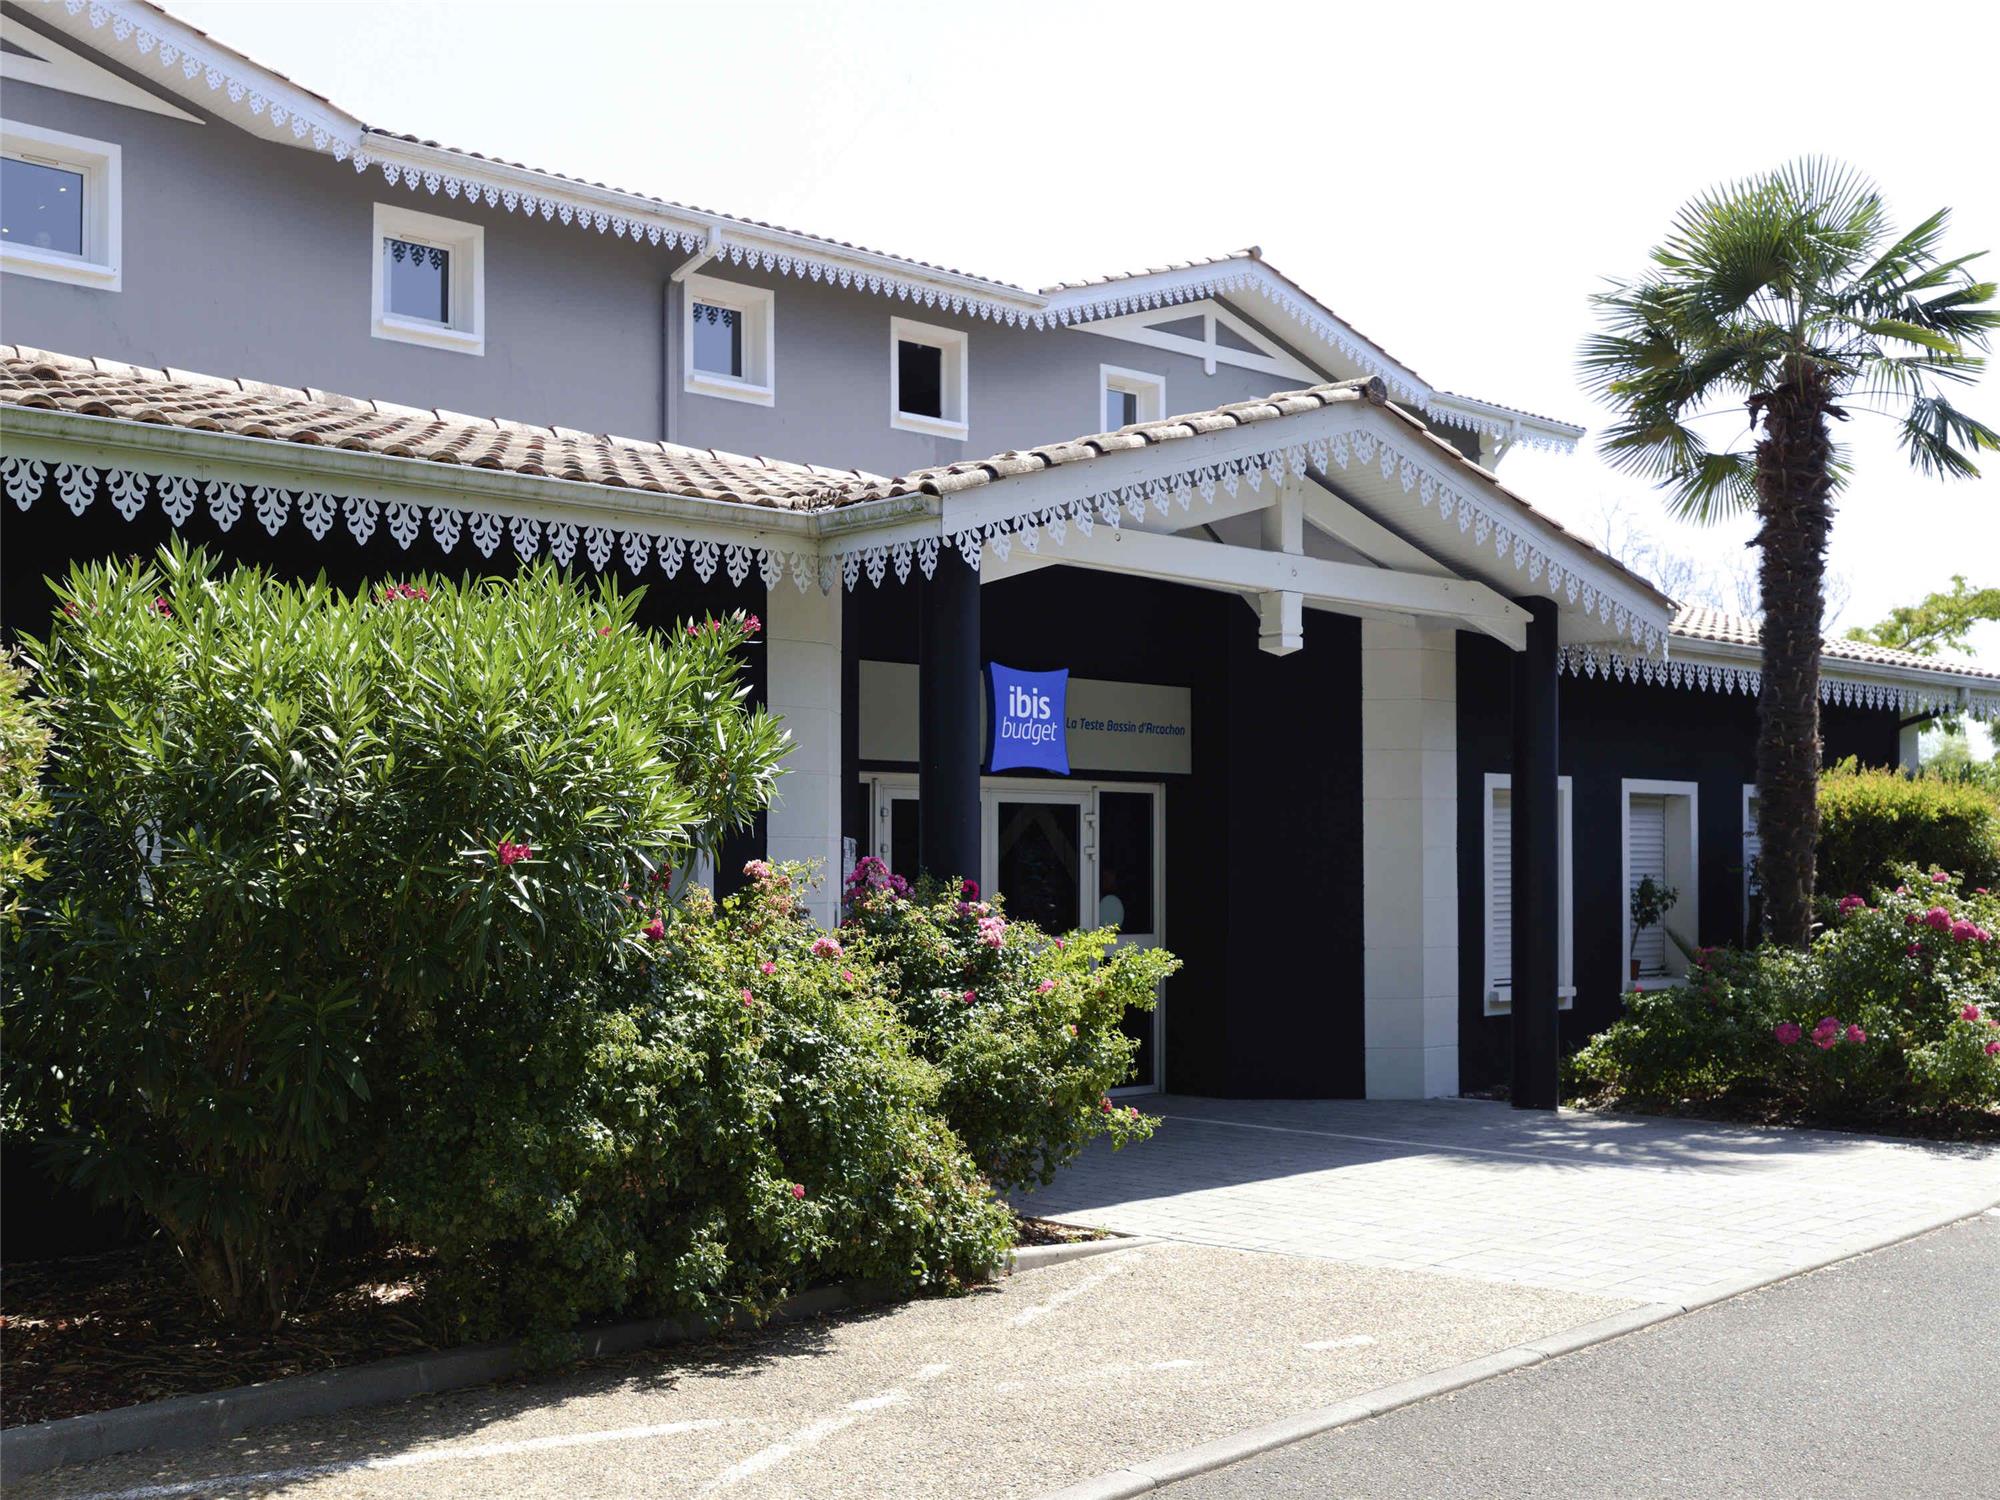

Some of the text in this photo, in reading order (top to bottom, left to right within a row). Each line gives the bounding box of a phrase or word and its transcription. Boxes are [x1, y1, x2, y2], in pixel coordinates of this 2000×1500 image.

[1009, 685, 1051, 720] ibis
[1002, 716, 1058, 746] budget
[1065, 717, 1186, 736] La Teste Bassin d'Arcachon
